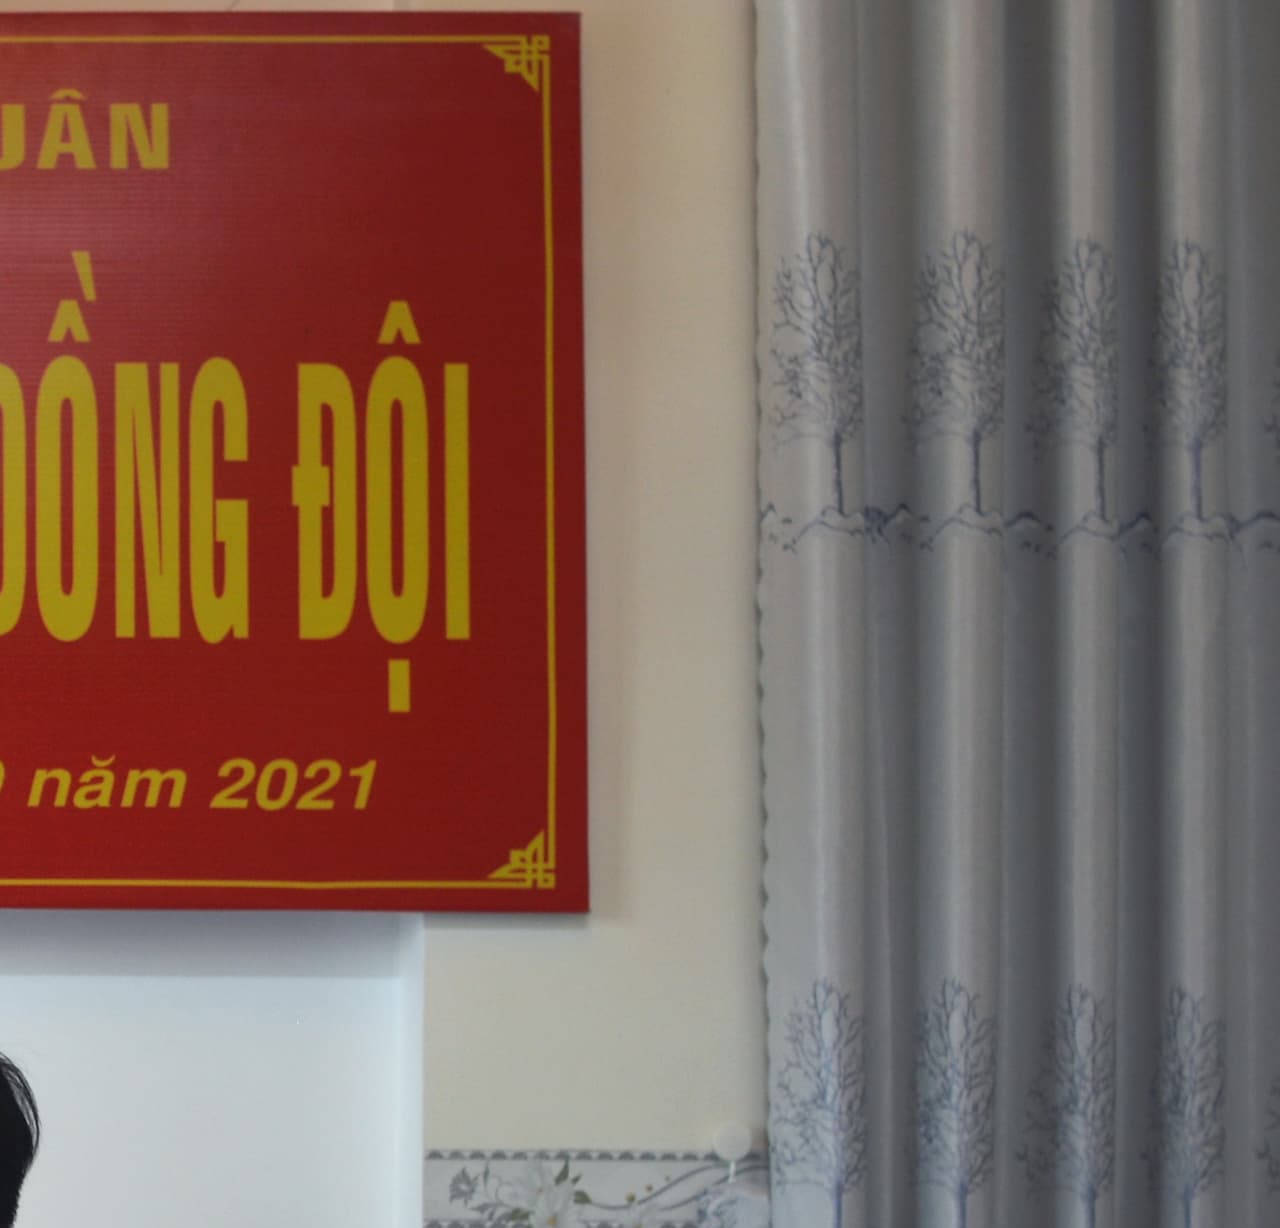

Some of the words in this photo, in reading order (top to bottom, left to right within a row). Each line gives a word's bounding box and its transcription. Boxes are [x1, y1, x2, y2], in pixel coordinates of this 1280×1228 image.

[291, 301, 470, 713] ĐỘI
[27, 755, 187, 808] năm
[209, 758, 377, 810] 2021
